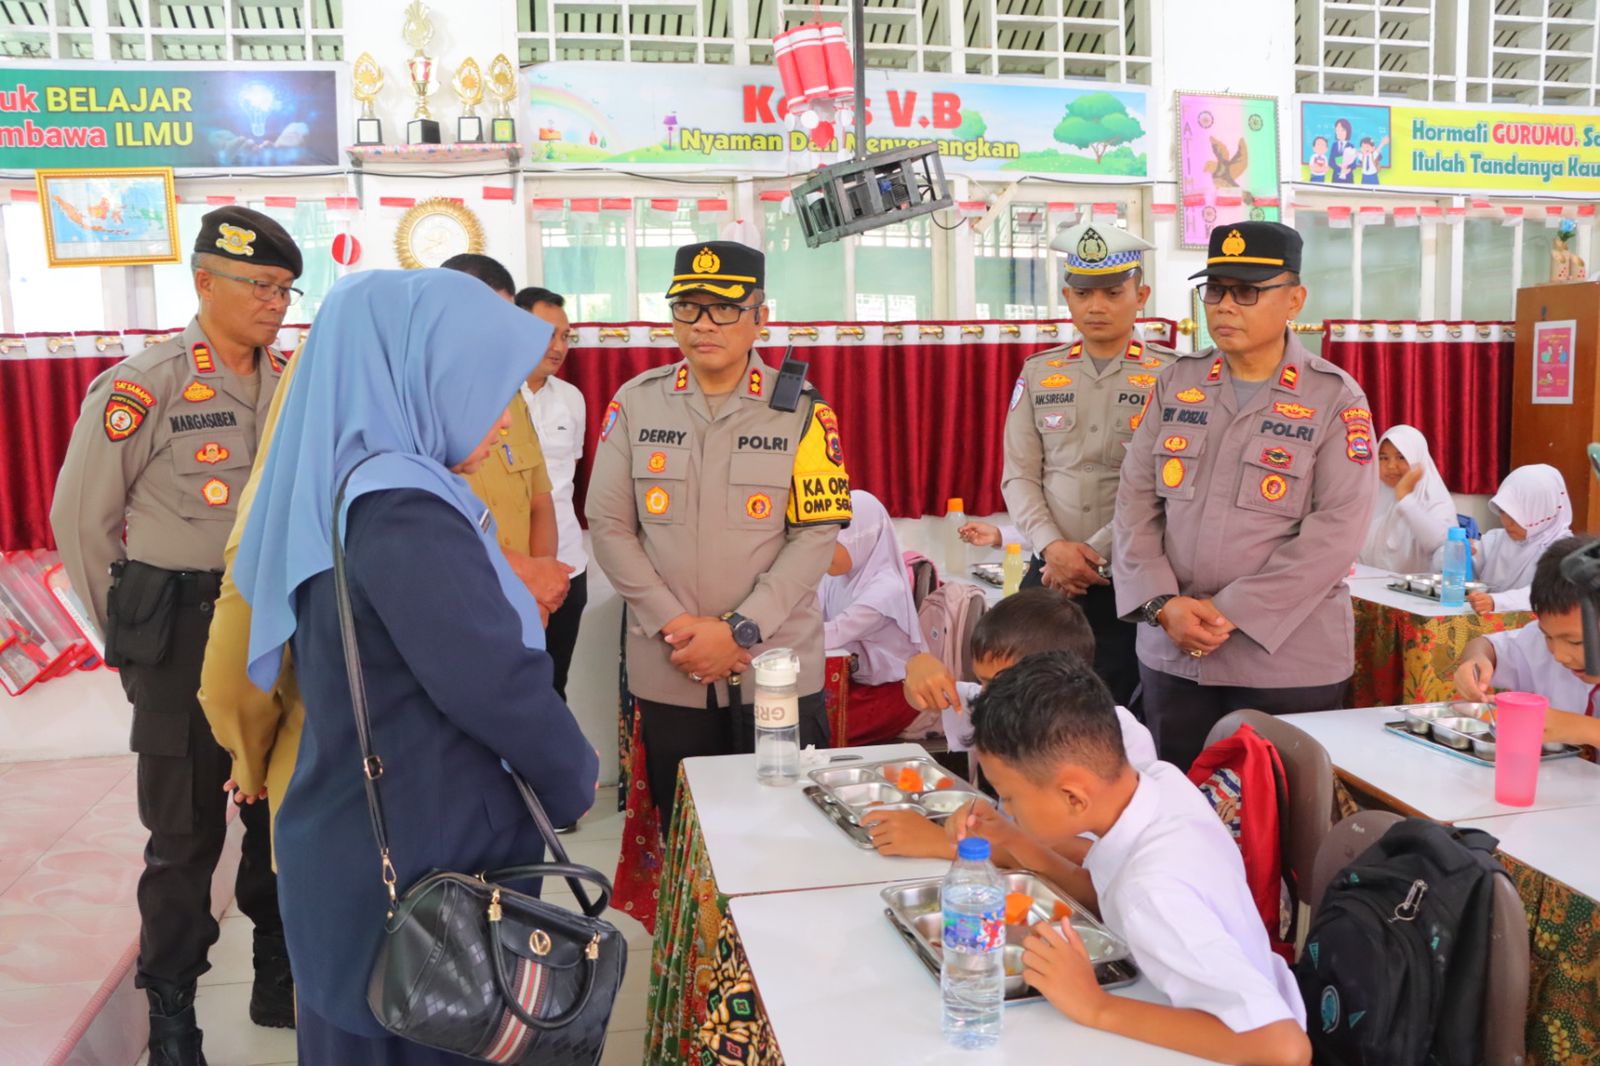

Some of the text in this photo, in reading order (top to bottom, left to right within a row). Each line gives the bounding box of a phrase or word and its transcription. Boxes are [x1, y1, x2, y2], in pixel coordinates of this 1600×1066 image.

[46, 86, 192, 113] BELAJAR
[886, 90, 963, 129] V.B
[115, 121, 193, 147] ILMU
[680, 128, 783, 155] Nyaman
[1412, 119, 1488, 143] Hormati
[1492, 122, 1580, 147] GURUMU,
[1412, 150, 1466, 173] Itulah
[1470, 153, 1564, 182] Tandanya
[1118, 393, 1147, 406] POL
[169, 411, 237, 433] MARGASIBEN
[1260, 420, 1315, 442] POLRI
[638, 428, 687, 446] DERRY
[738, 436, 788, 451] POLRI
[803, 477, 825, 497] KA
[803, 499, 832, 514] OMP
